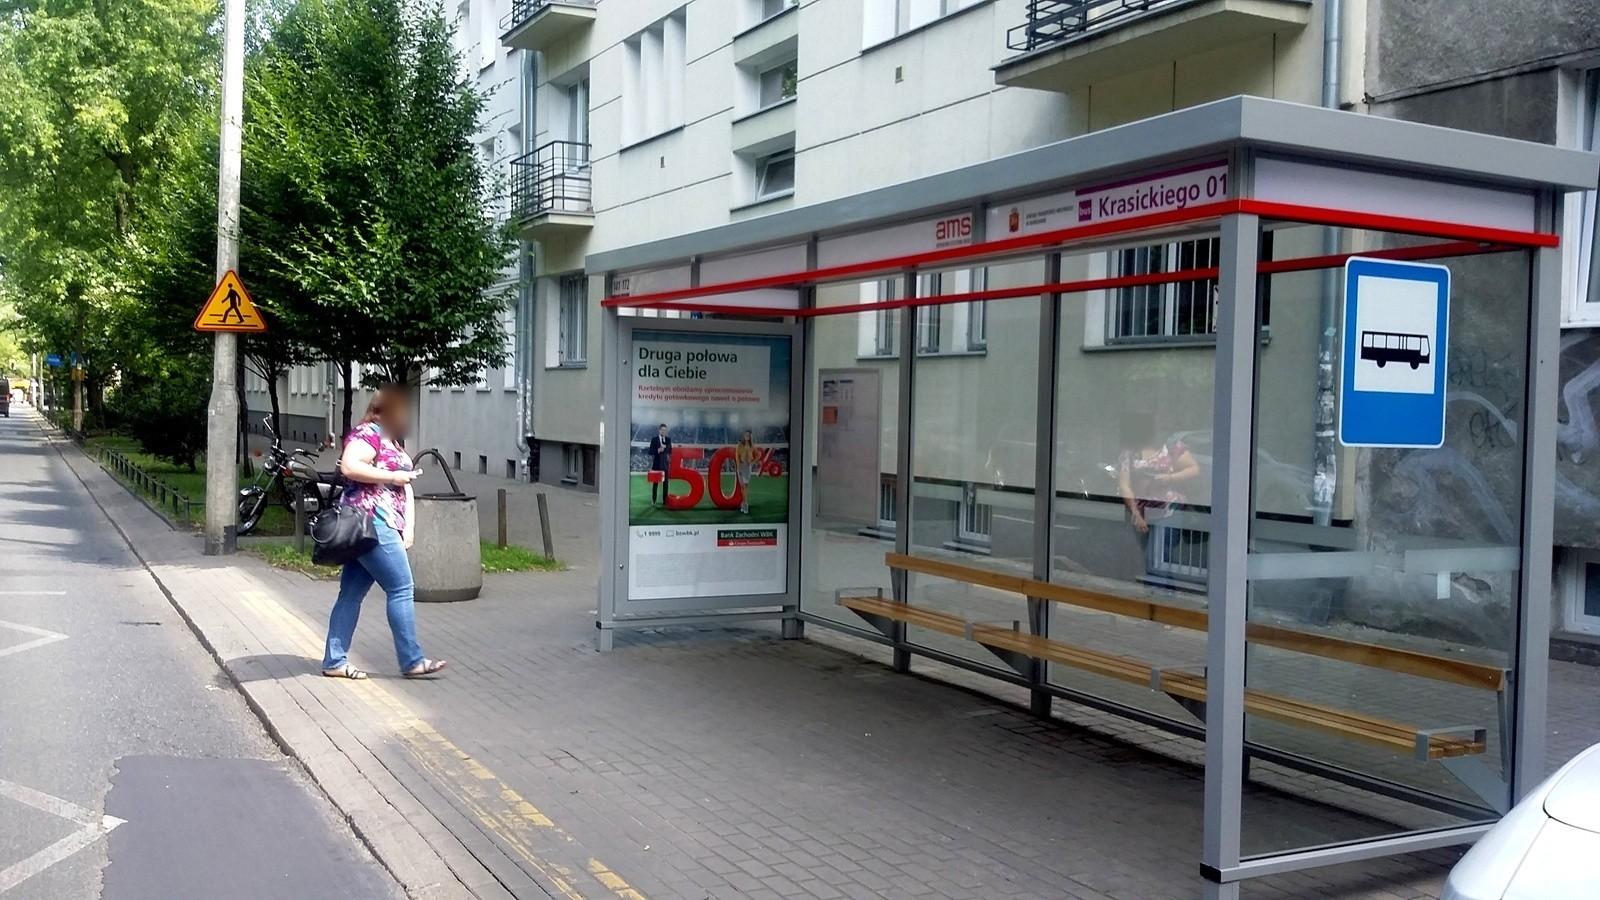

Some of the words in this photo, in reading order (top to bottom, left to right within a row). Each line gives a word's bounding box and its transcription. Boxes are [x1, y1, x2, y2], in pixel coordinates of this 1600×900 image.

[1098, 182, 1201, 217] Krasickiego
[1206, 173, 1228, 197] 01
[1079, 205, 1092, 216] bus
[936, 217, 971, 241] ams
[638, 347, 682, 364] Druga
[686, 349, 738, 364] połowa
[638, 364, 660, 378] dla
[664, 366, 707, 380] Ciebie
[735, 530, 760, 538] Zachodni
